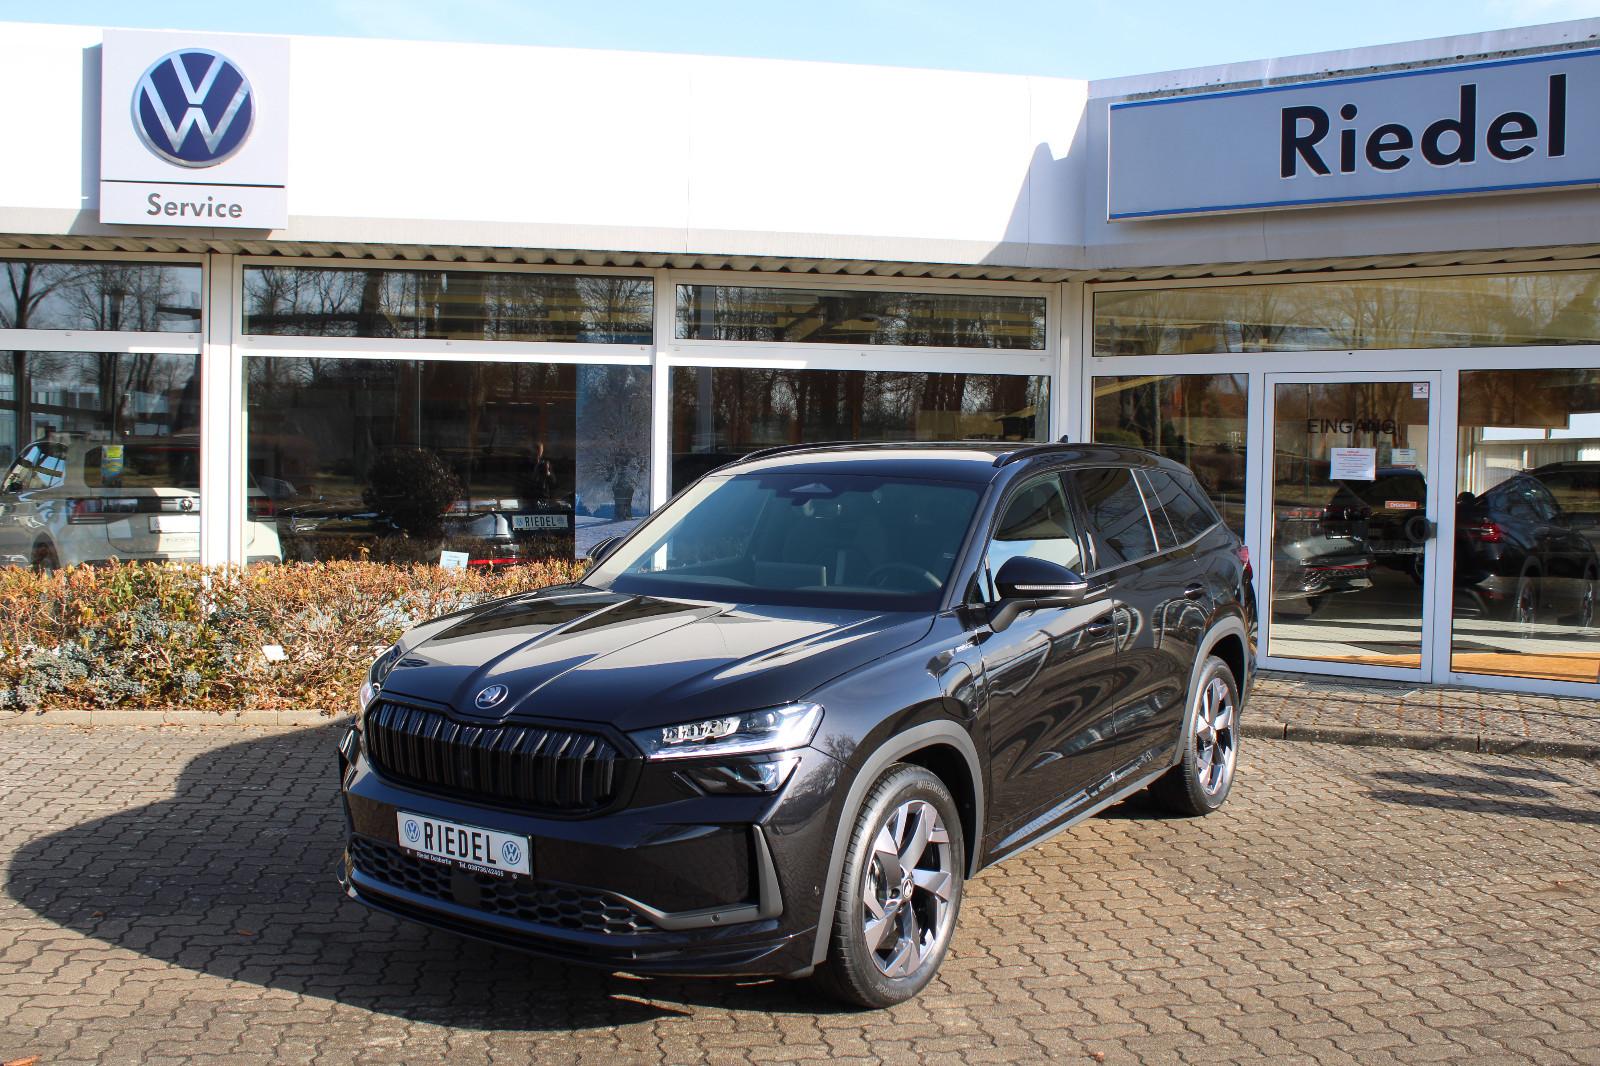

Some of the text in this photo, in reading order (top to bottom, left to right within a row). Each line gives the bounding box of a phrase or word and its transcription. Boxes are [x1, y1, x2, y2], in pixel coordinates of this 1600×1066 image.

[1280, 73, 1567, 179] Riedel
[146, 192, 243, 219] Service
[1307, 418, 1396, 434] EINGANG
[525, 516, 556, 527] RIEDEL
[424, 822, 496, 864] RIEDEL
